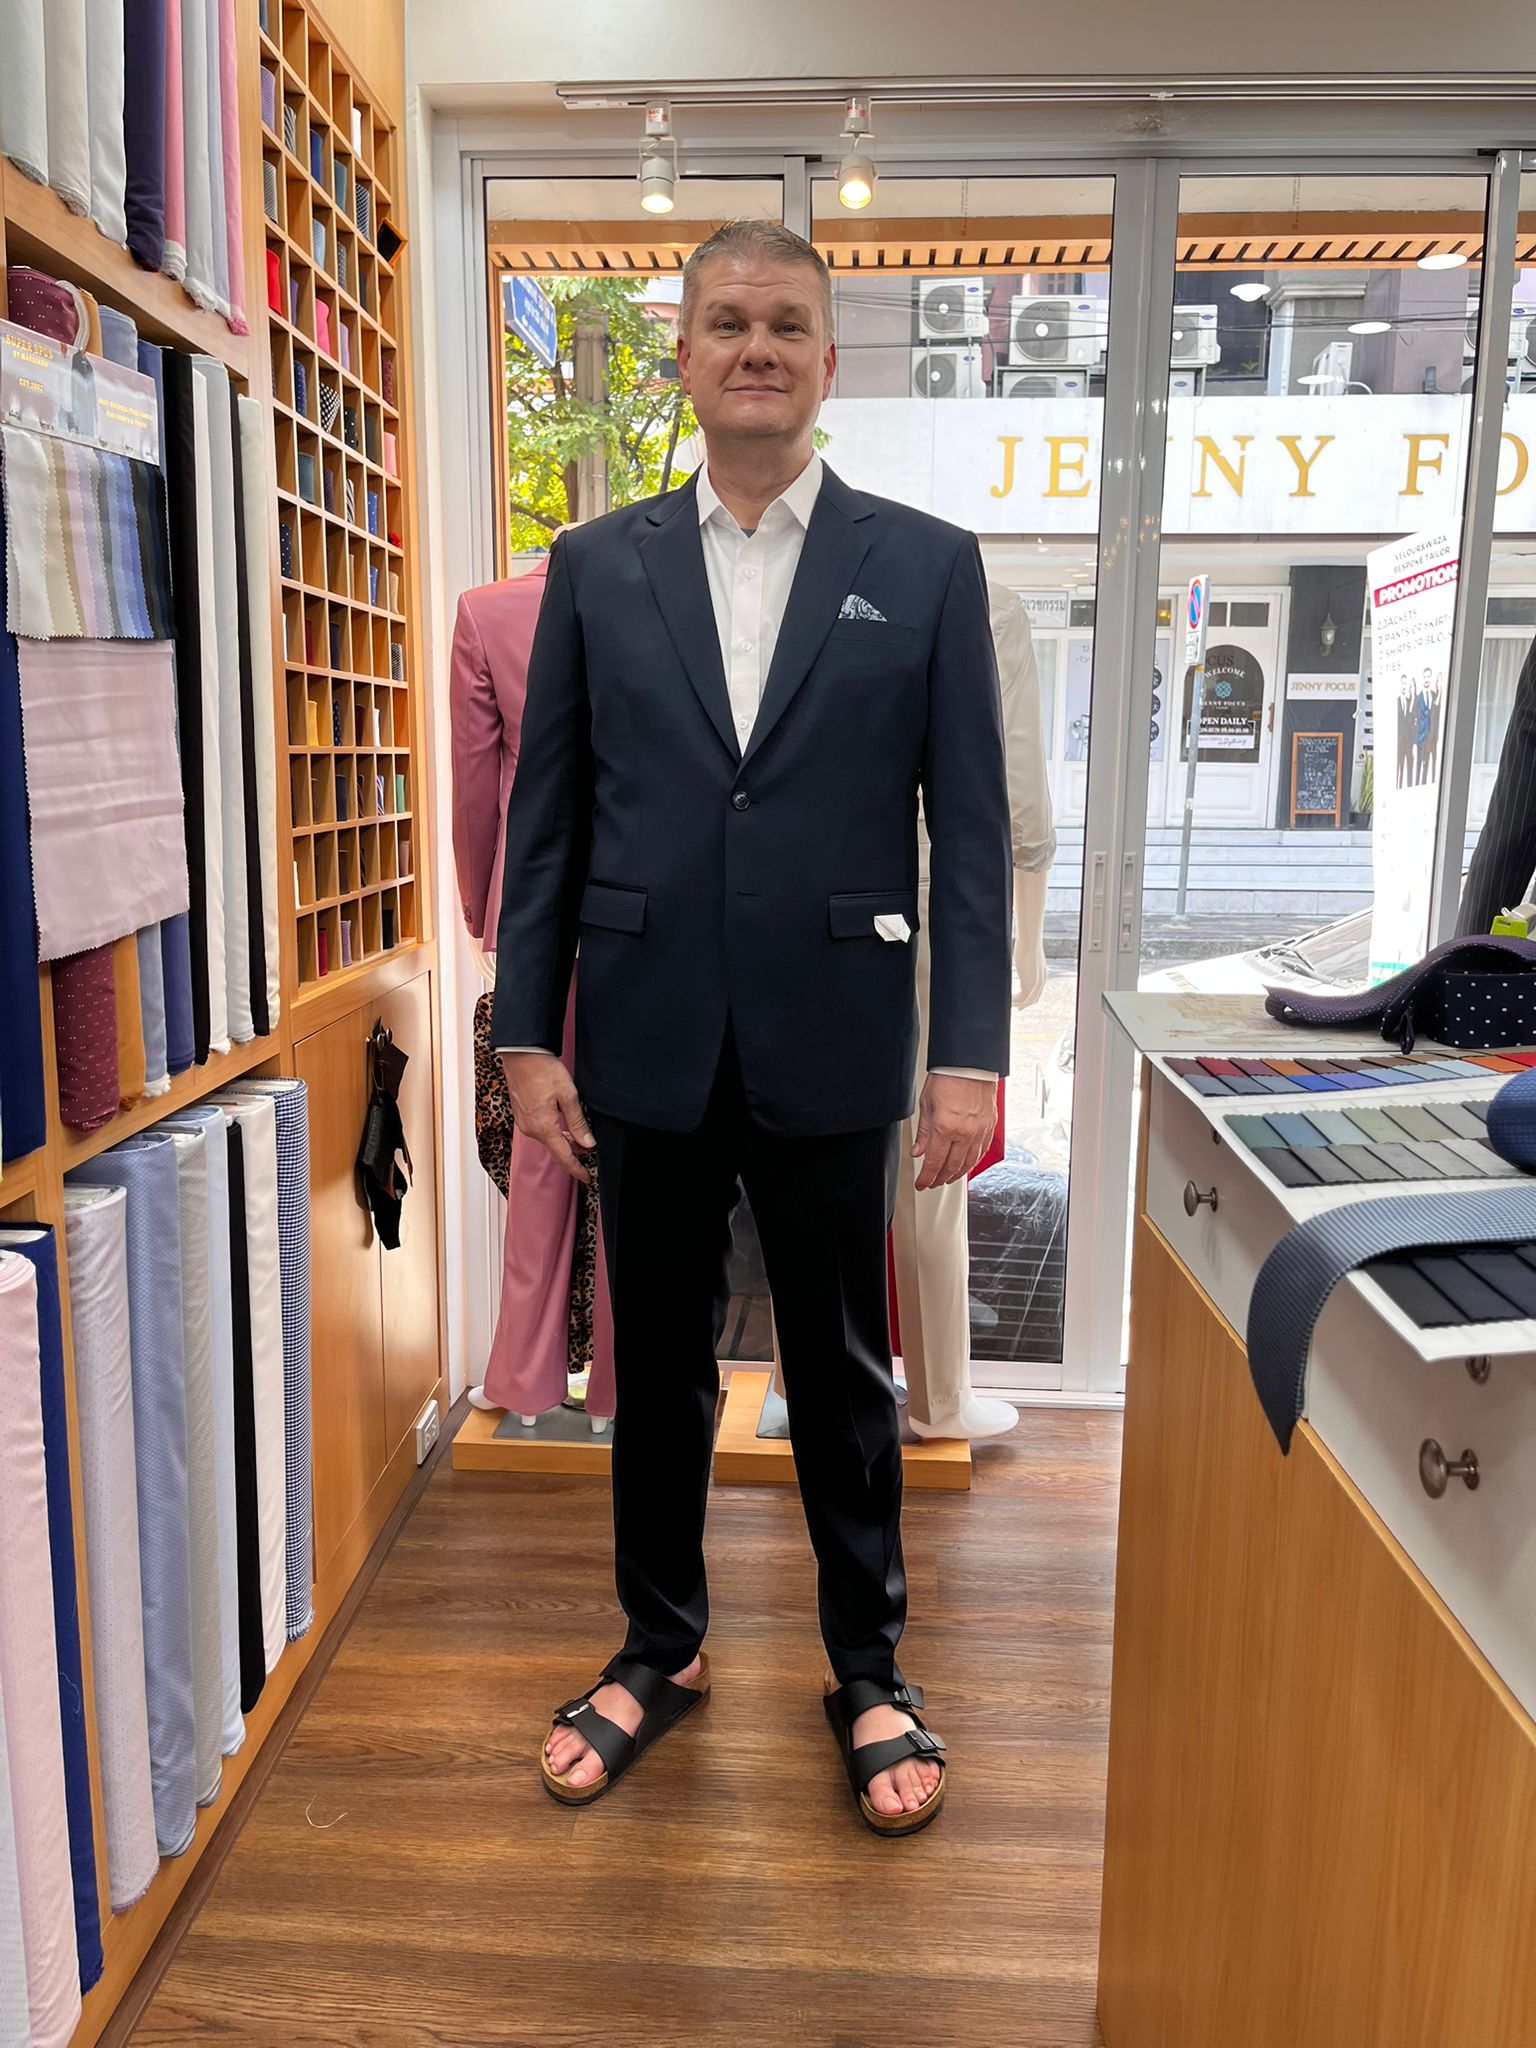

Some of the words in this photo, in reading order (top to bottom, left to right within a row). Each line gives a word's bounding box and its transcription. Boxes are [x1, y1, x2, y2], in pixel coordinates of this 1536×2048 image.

[990, 435, 1335, 498] JENY
[1394, 556, 1423, 574] BESPOKE
[1425, 546, 1450, 561] TAILOR
[1379, 563, 1459, 605] PROMOTION
[1383, 609, 1418, 628] JACKETS
[1204, 666, 1245, 678] WELCOME
[1291, 682, 1322, 691] JENNY
[1325, 682, 1356, 691] FOCUS
[1220, 717, 1248, 725] DAILY
